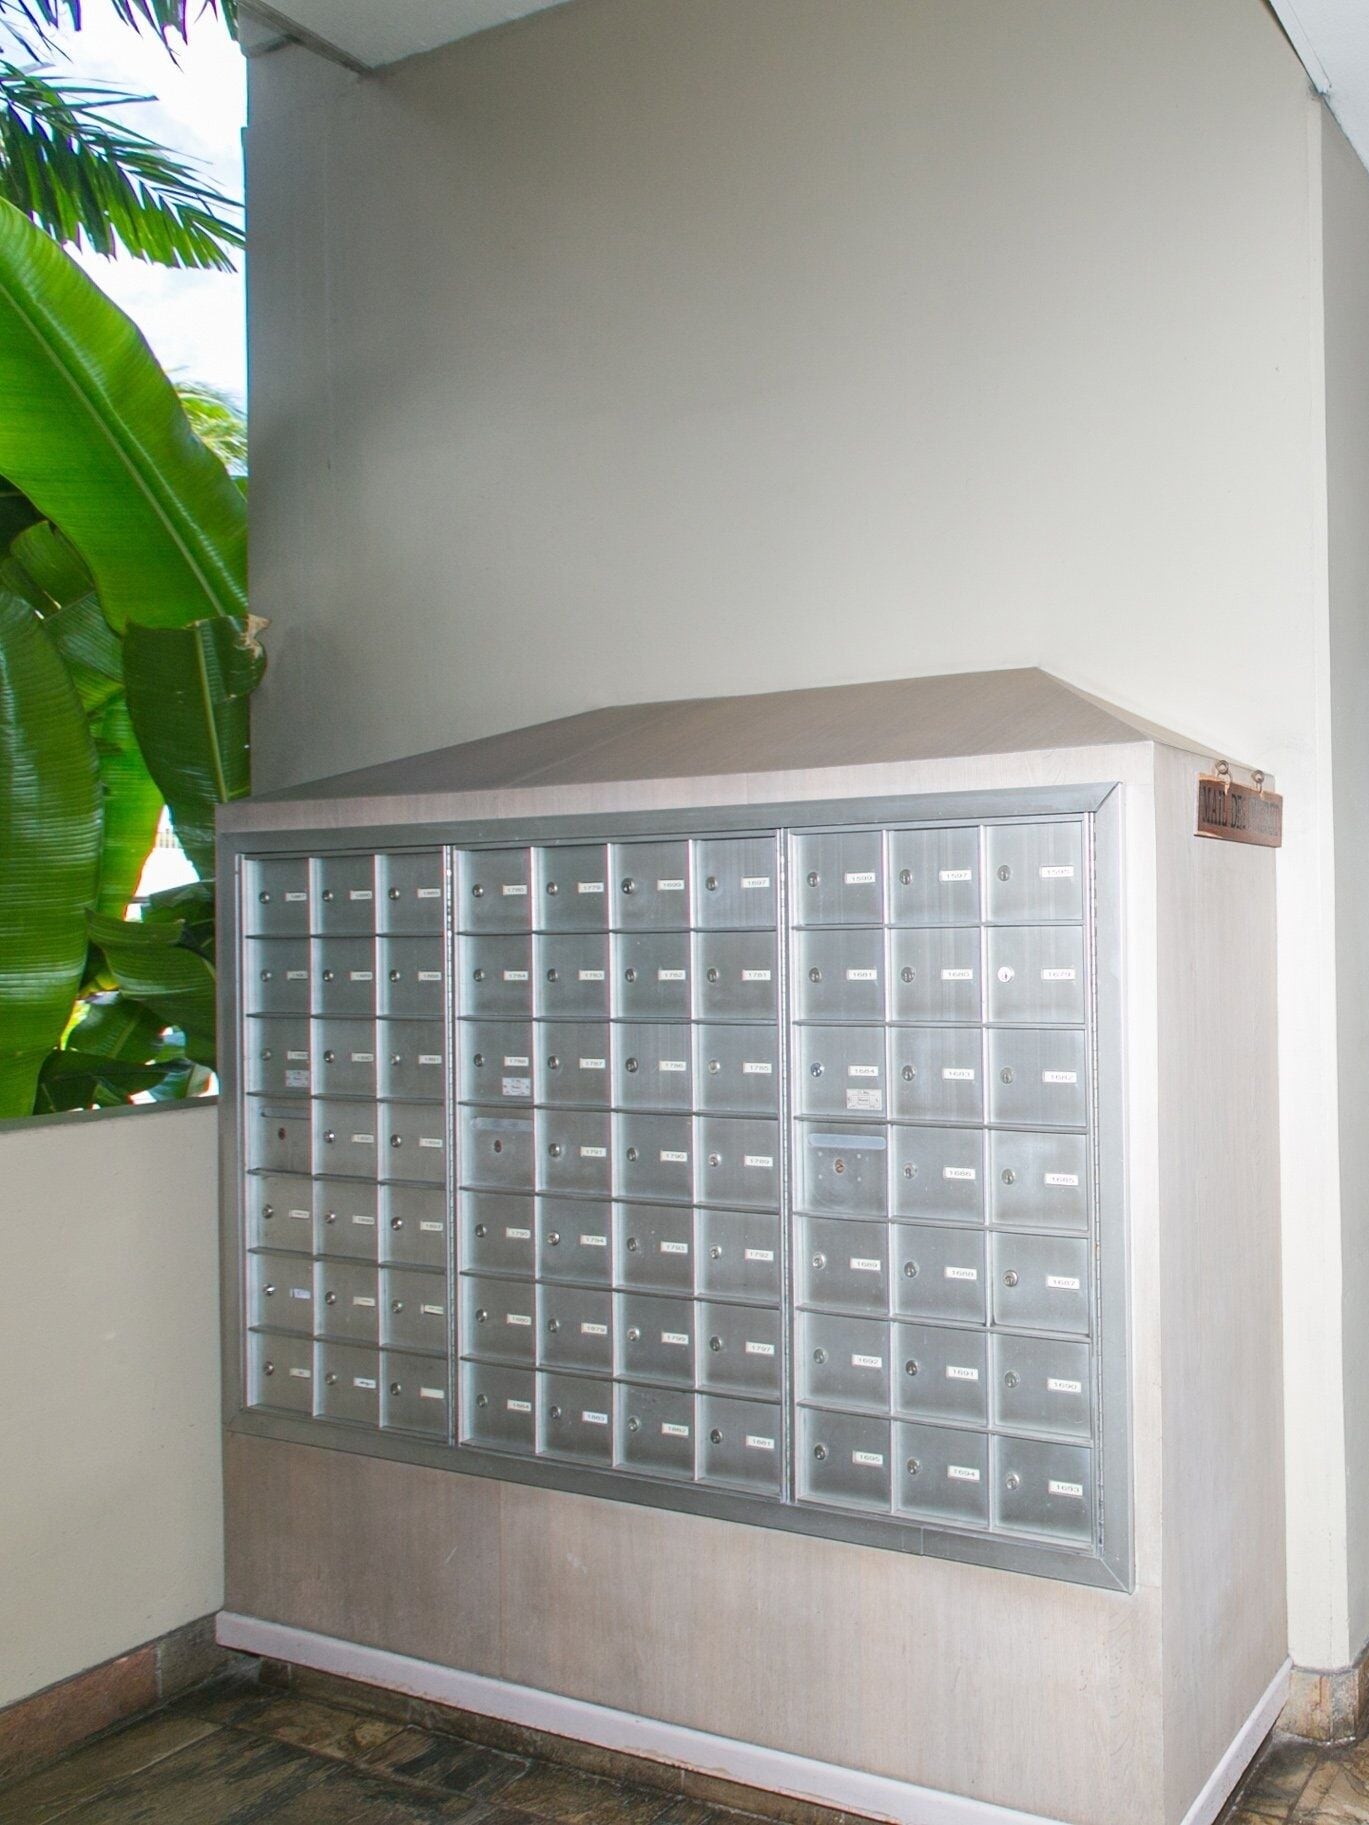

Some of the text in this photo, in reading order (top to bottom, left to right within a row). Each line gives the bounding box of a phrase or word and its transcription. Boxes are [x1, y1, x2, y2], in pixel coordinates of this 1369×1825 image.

[1200, 785, 1227, 827] MAIL
[858, 1357, 878, 1365] 1692
[954, 1469, 975, 1477] 1694
[1057, 1485, 1079, 1493] 1693
